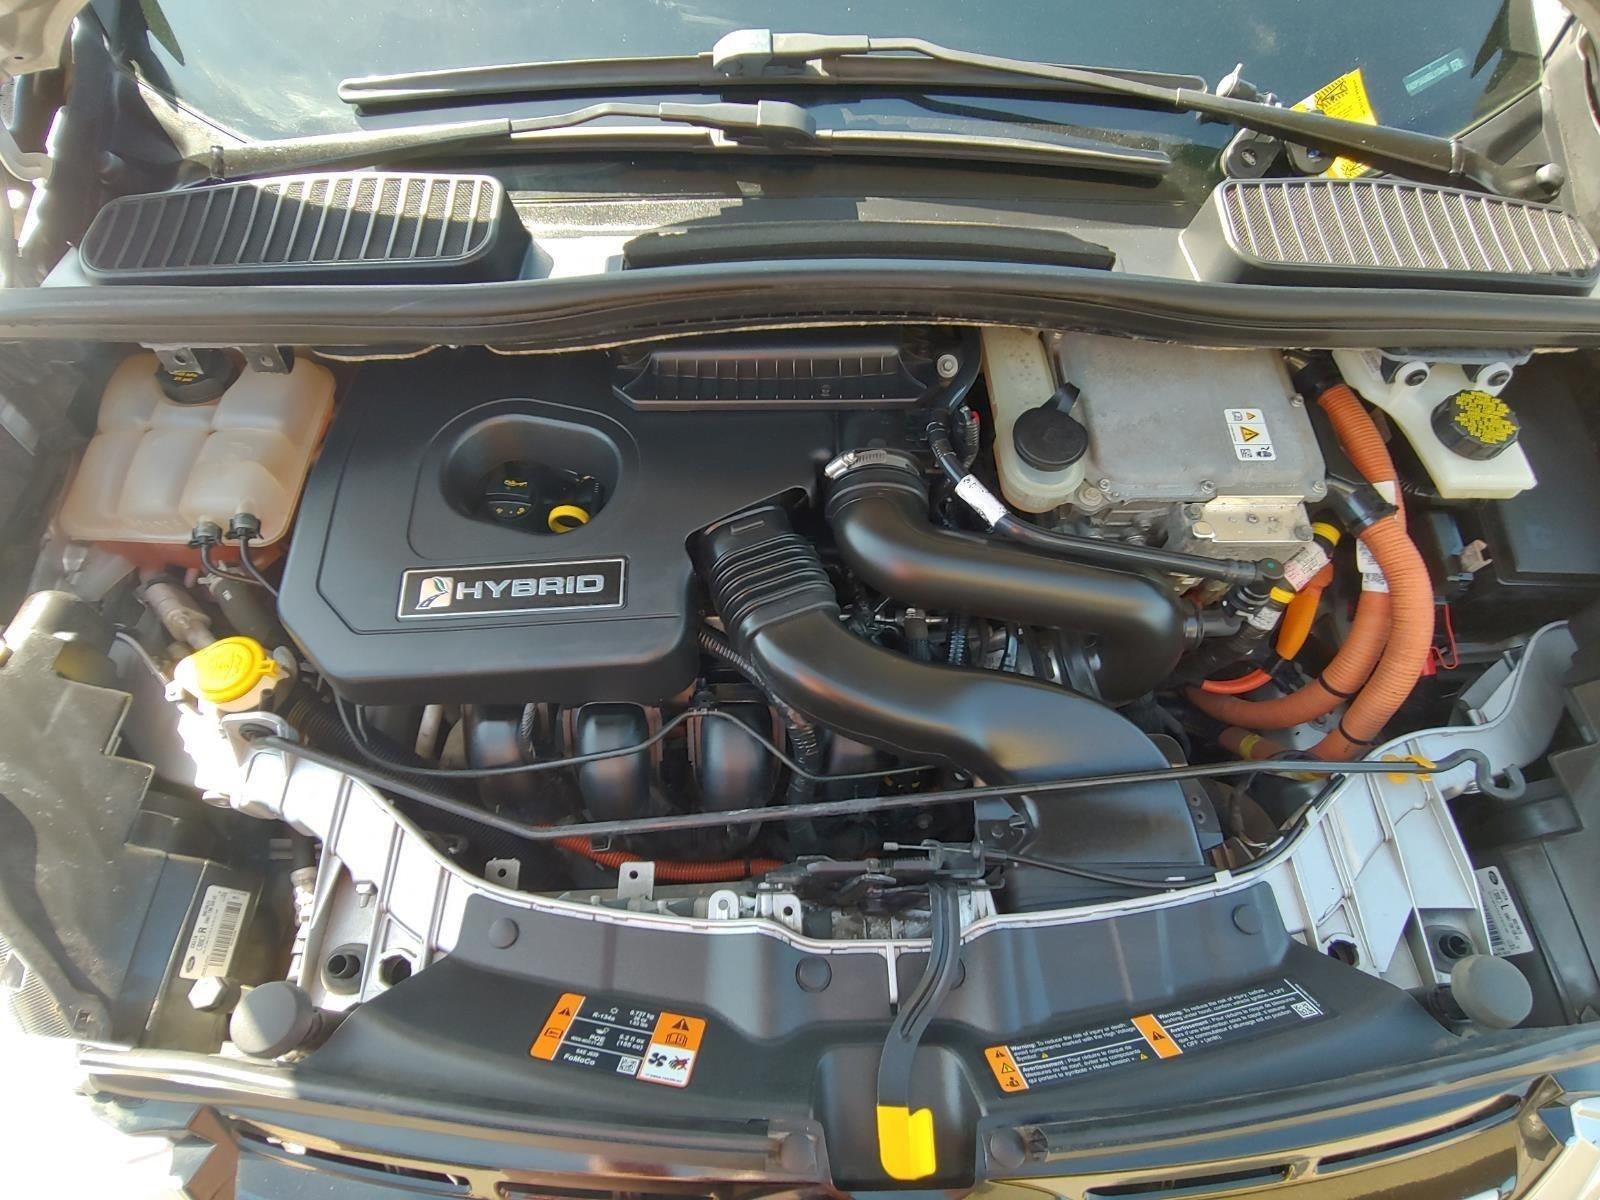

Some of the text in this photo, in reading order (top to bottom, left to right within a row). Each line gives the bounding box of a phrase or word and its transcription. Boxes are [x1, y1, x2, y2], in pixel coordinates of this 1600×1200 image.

[456, 574, 604, 600] HYBRID
[593, 1012, 615, 1021] R-134a
[564, 1054, 595, 1065] FoMoCo
